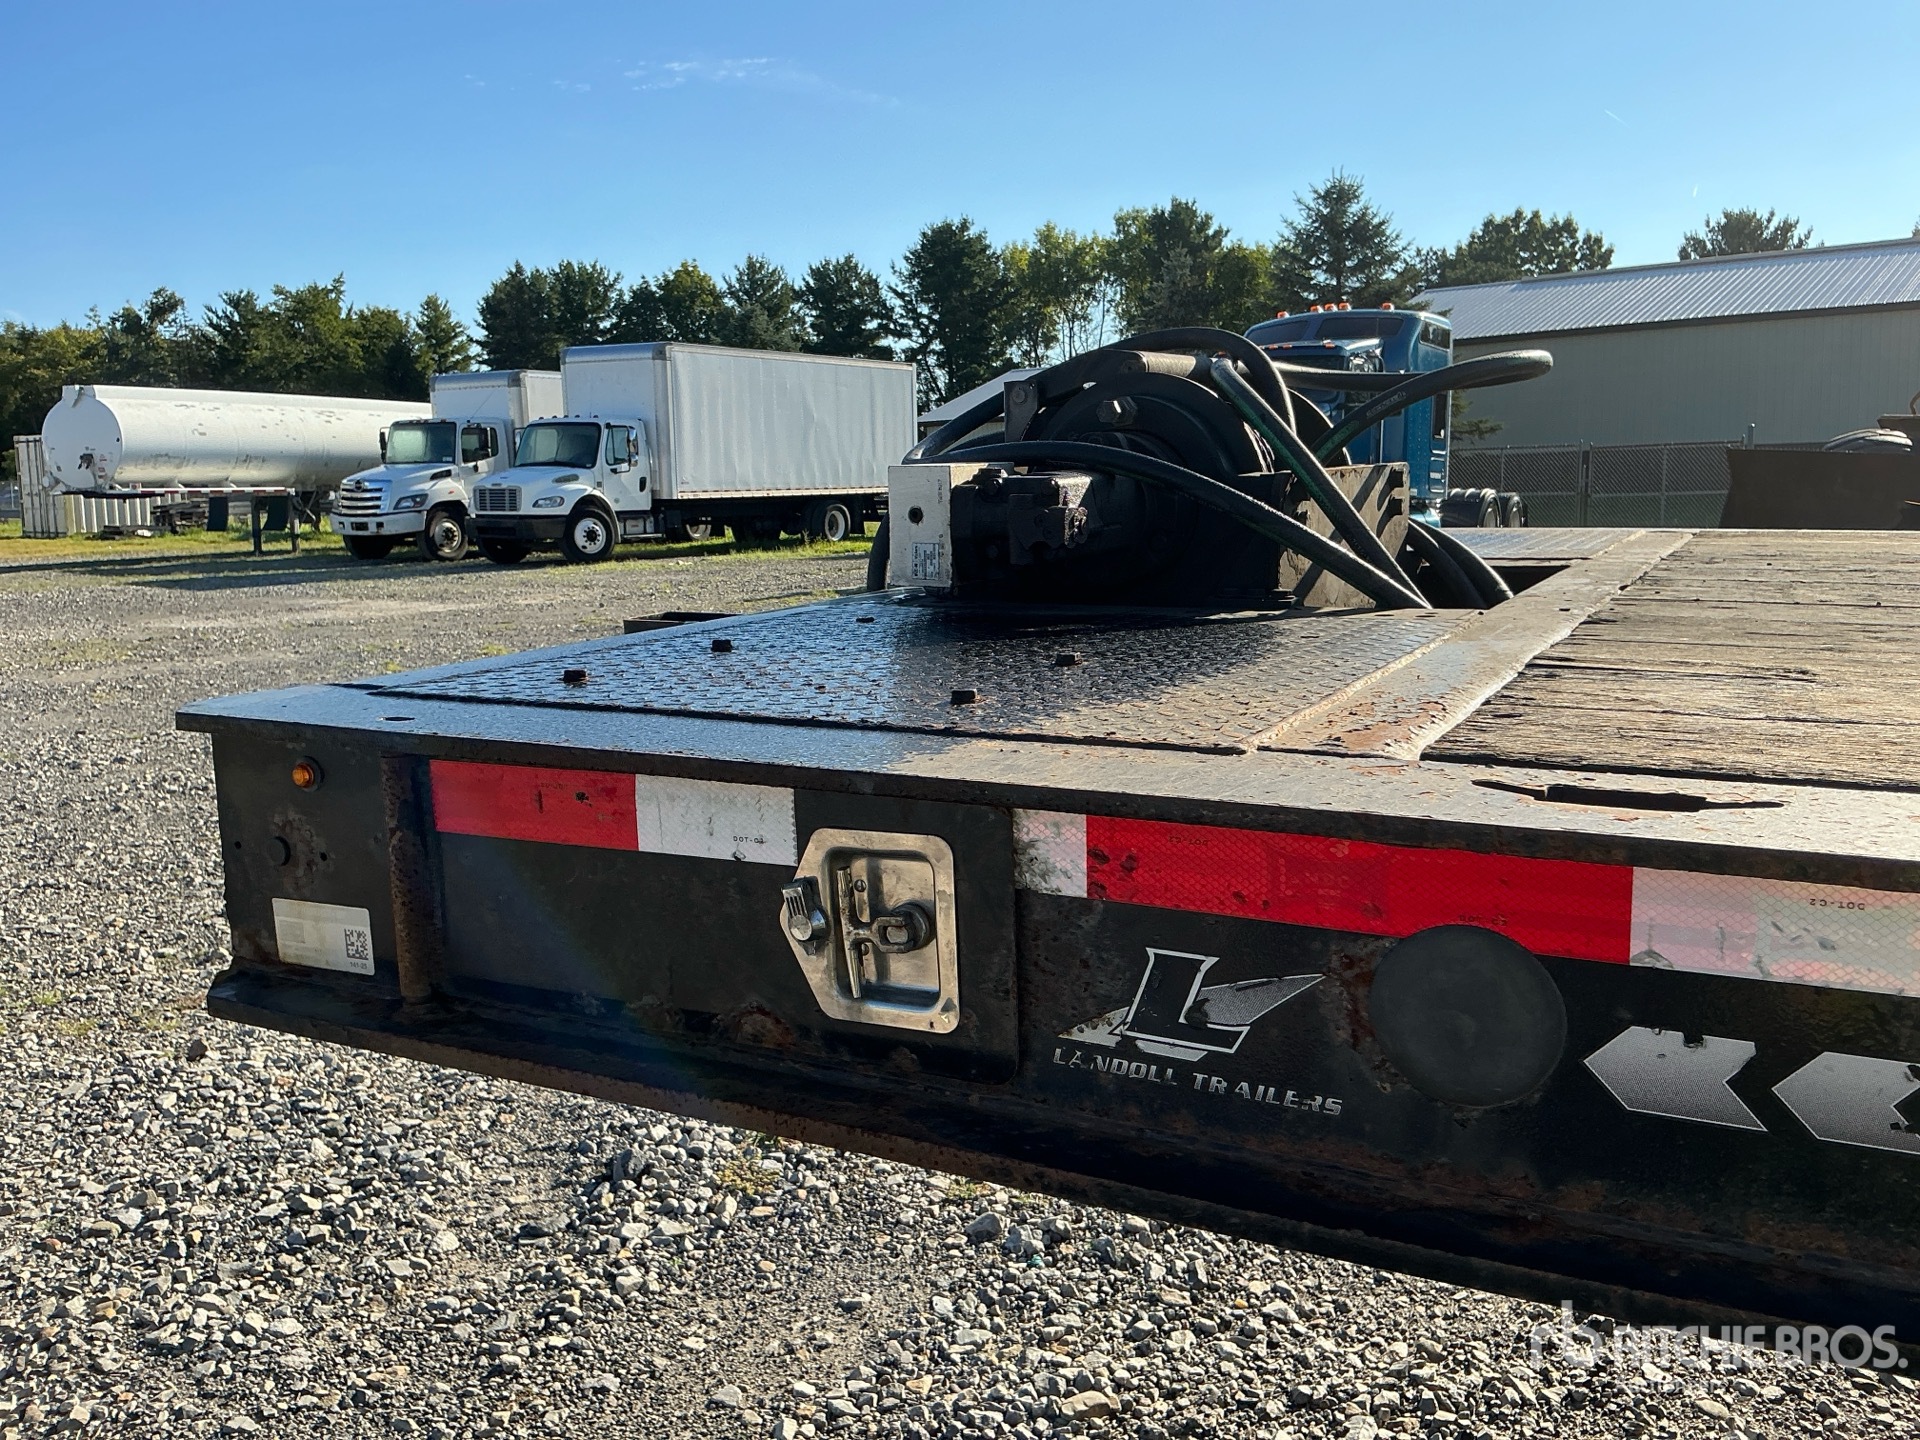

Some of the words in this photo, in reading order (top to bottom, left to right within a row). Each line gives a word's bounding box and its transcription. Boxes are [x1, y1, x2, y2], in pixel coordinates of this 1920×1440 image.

[1809, 898, 1866, 911] DOT-C2
[1052, 1047, 1178, 1086] LANDOLL
[1192, 1071, 1344, 1116] TRAILERS
